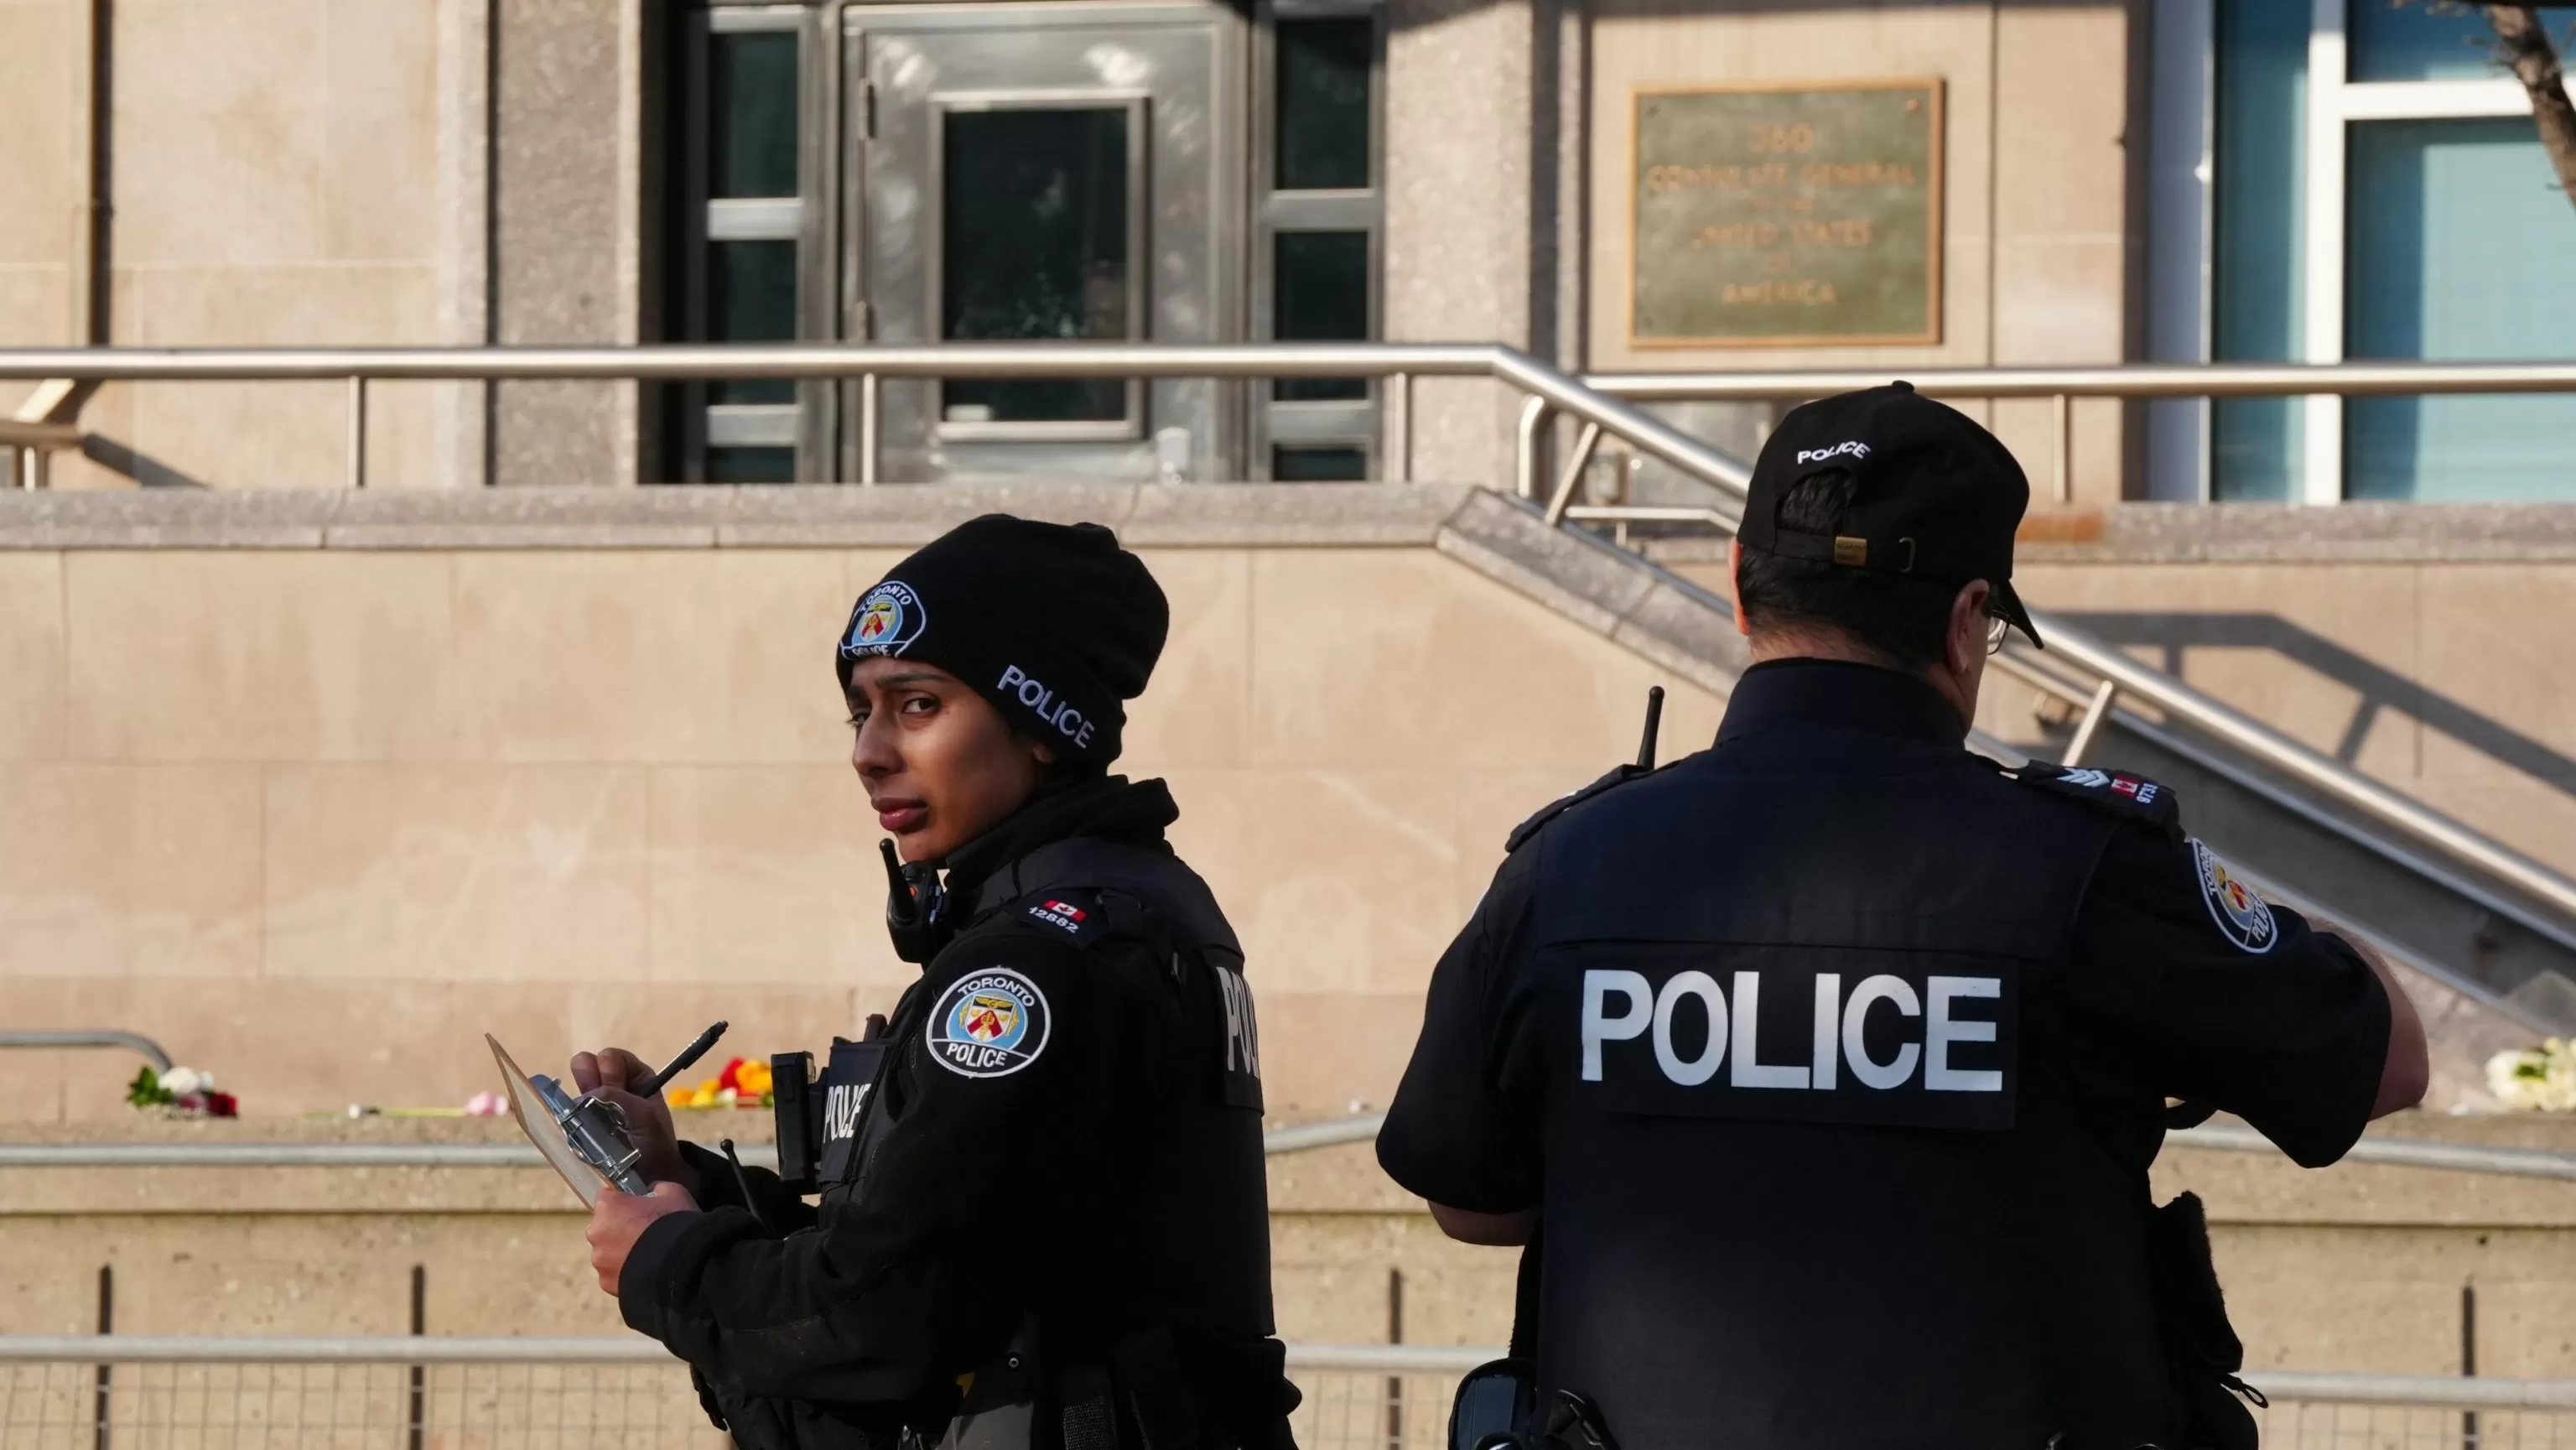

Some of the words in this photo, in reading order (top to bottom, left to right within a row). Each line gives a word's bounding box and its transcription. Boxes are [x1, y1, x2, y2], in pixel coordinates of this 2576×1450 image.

[1796, 440, 1872, 465] POLICE
[860, 585, 912, 612] TORONTO
[996, 664, 1095, 749] POLICE
[958, 977, 1035, 1007] TORONTO
[1581, 969, 2002, 1090] POLICE
[946, 1042, 1008, 1068] POLICE
